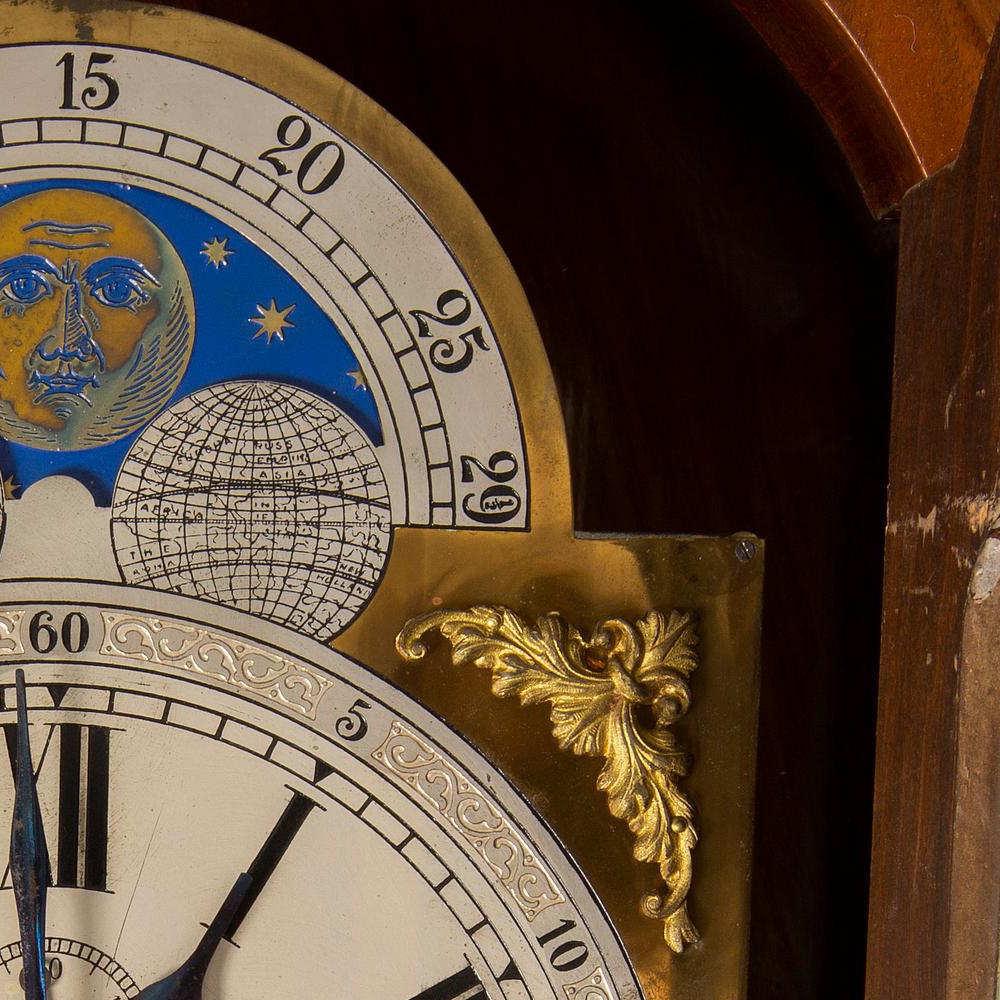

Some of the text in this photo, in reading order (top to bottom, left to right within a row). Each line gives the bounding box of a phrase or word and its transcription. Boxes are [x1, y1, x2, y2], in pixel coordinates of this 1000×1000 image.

[55, 51, 120, 111] 15
[258, 115, 346, 196] 20
[408, 289, 491, 374] 25
[28, 610, 90, 655] 60
[335, 698, 372, 742] 5
[535, 918, 589, 972] 10
